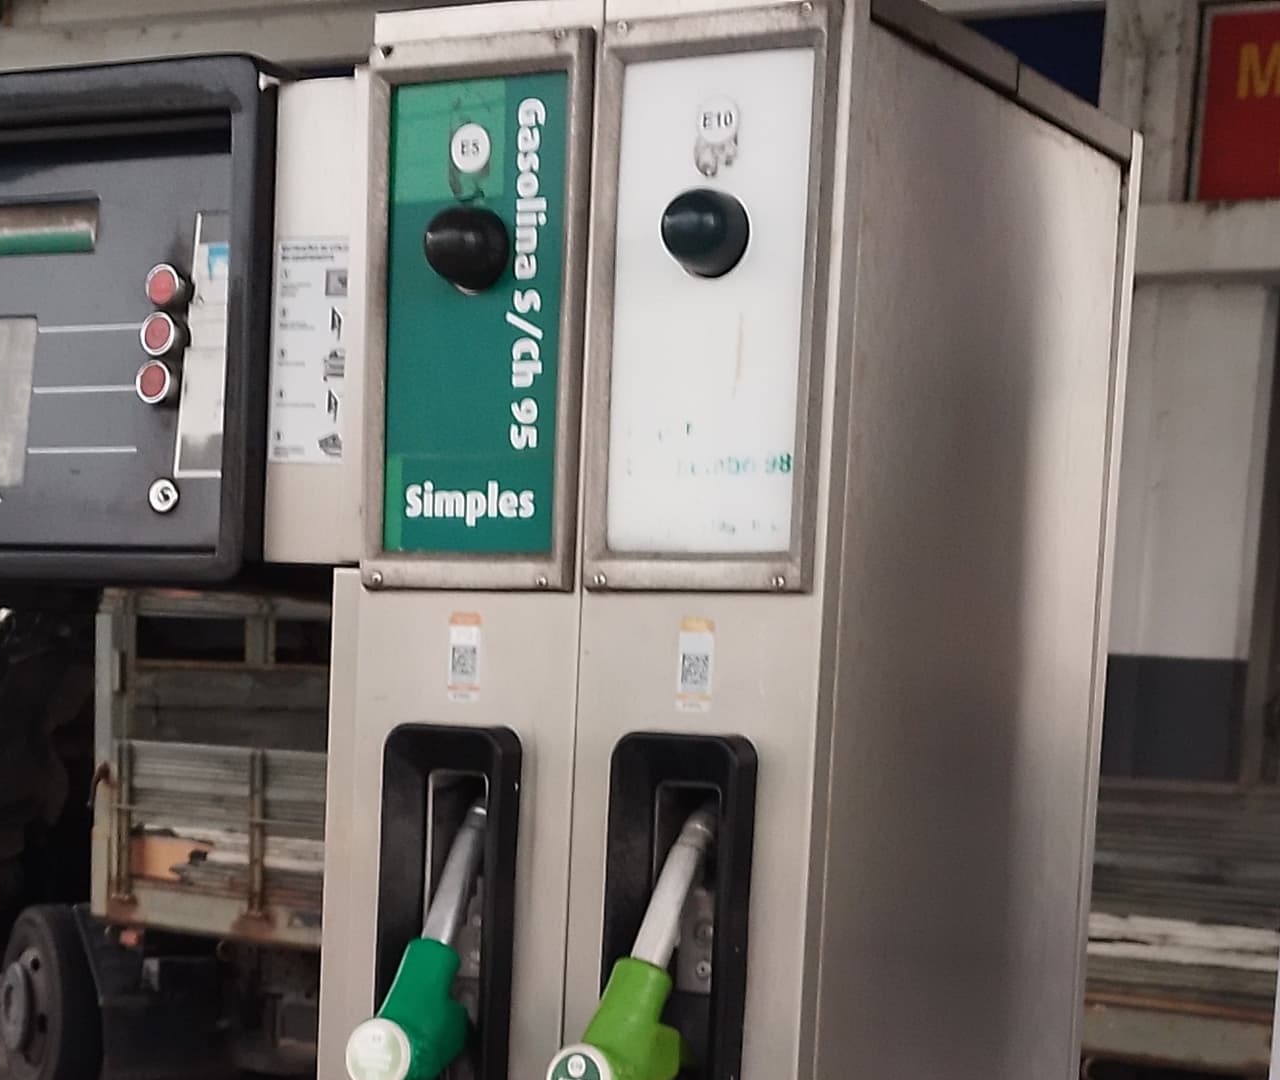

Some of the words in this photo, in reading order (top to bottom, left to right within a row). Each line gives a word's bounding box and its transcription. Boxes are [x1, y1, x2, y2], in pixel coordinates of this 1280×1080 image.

[702, 111, 733, 129] E10
[460, 139, 481, 155] E5
[513, 97, 548, 281] Gasolina
[505, 287, 545, 390] S/Ch
[508, 396, 540, 451] 95
[405, 480, 535, 527] Simples
